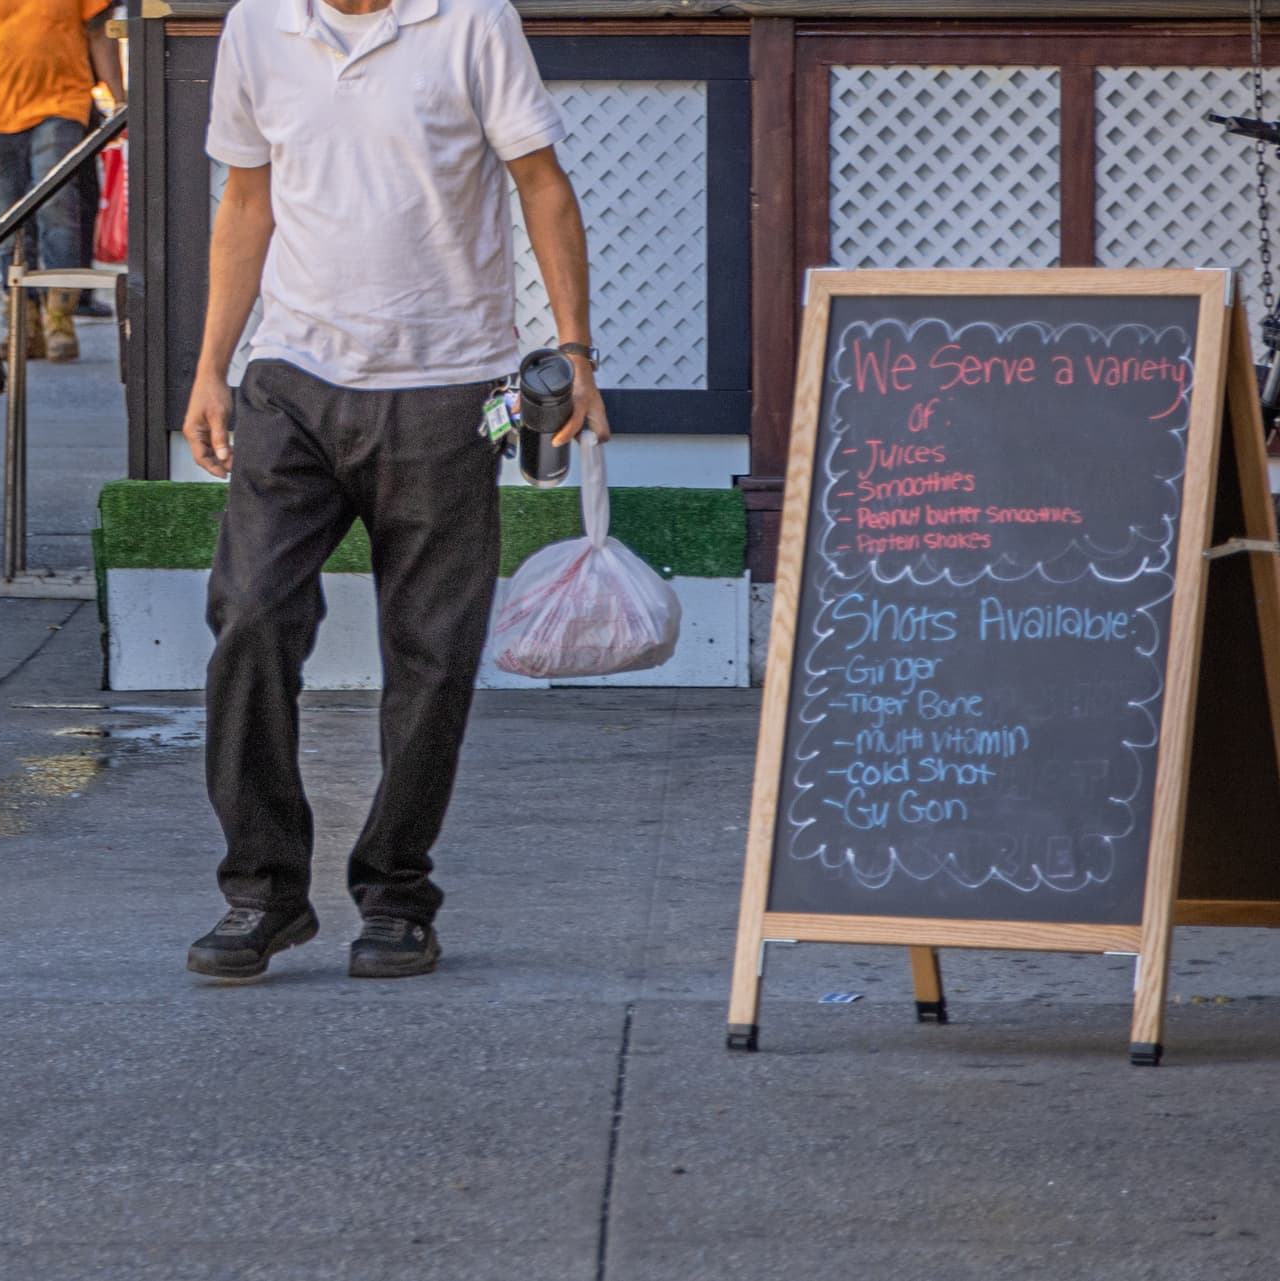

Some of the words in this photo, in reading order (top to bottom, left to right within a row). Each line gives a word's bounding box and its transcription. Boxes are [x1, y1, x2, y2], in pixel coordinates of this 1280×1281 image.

[853, 337, 918, 395] We
[1051, 355, 1074, 385] a
[831, 592, 958, 651] Shots
[918, 689, 984, 720] Bone
